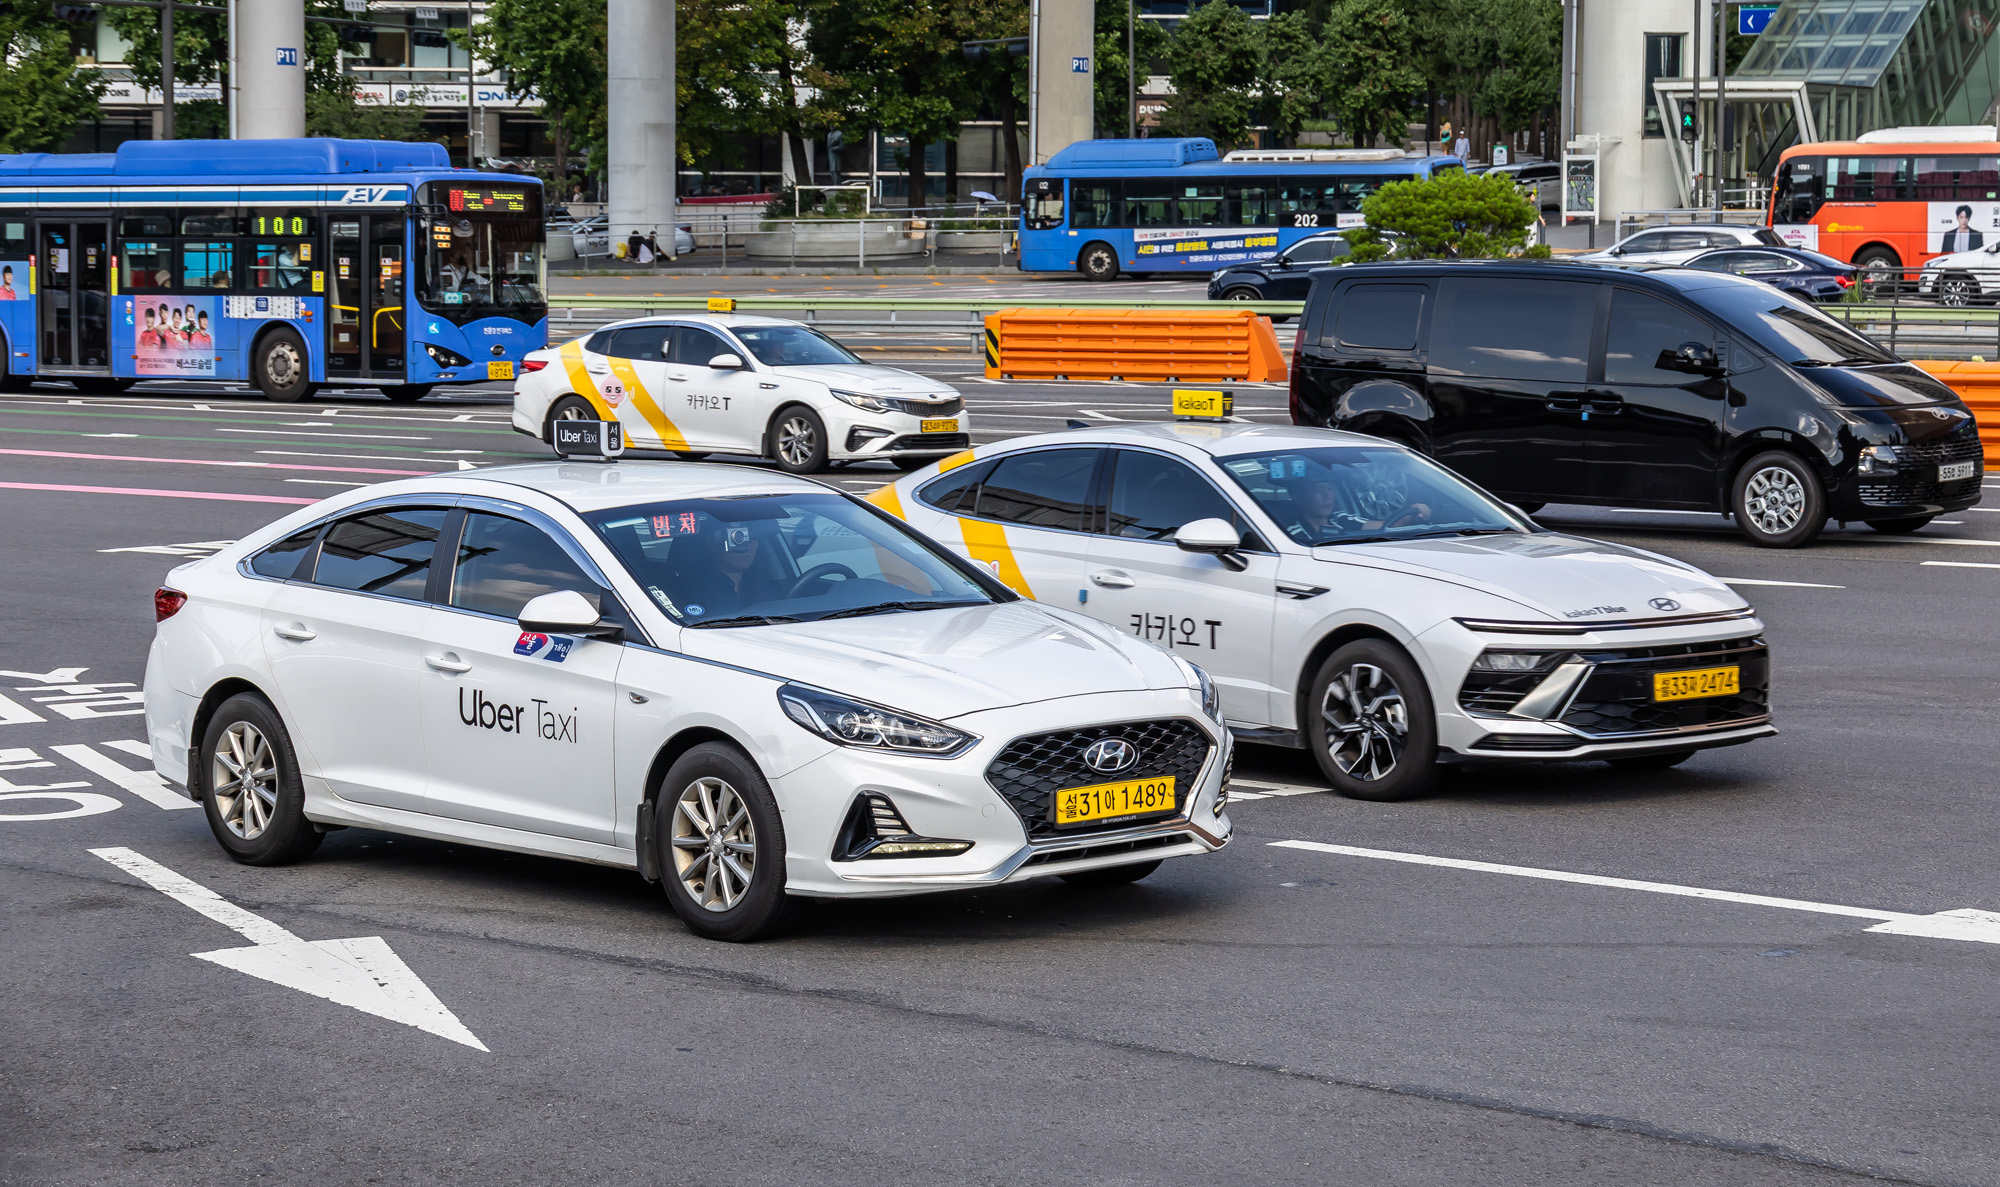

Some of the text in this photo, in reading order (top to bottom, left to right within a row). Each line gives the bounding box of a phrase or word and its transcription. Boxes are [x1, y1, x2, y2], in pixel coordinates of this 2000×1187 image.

[277, 49, 296, 63] P11
[1073, 59, 1088, 71] P10
[352, 188, 383, 203] EV
[258, 217, 303, 235] 100
[1294, 214, 1318, 227] 202
[494, 368, 512, 378] 8741
[687, 394, 731, 411] 카카오 T
[560, 429, 597, 444] Uber Taxi
[610, 425, 618, 448] 서울
[1130, 612, 1222, 649] 카카오 T
[520, 633, 537, 650] 서울
[554, 643, 570, 658] 개인
[1700, 671, 1733, 693] 2474
[459, 686, 577, 744] Uber Taxi
[1065, 793, 1077, 818] 서울
[1122, 782, 1167, 810] 1489
